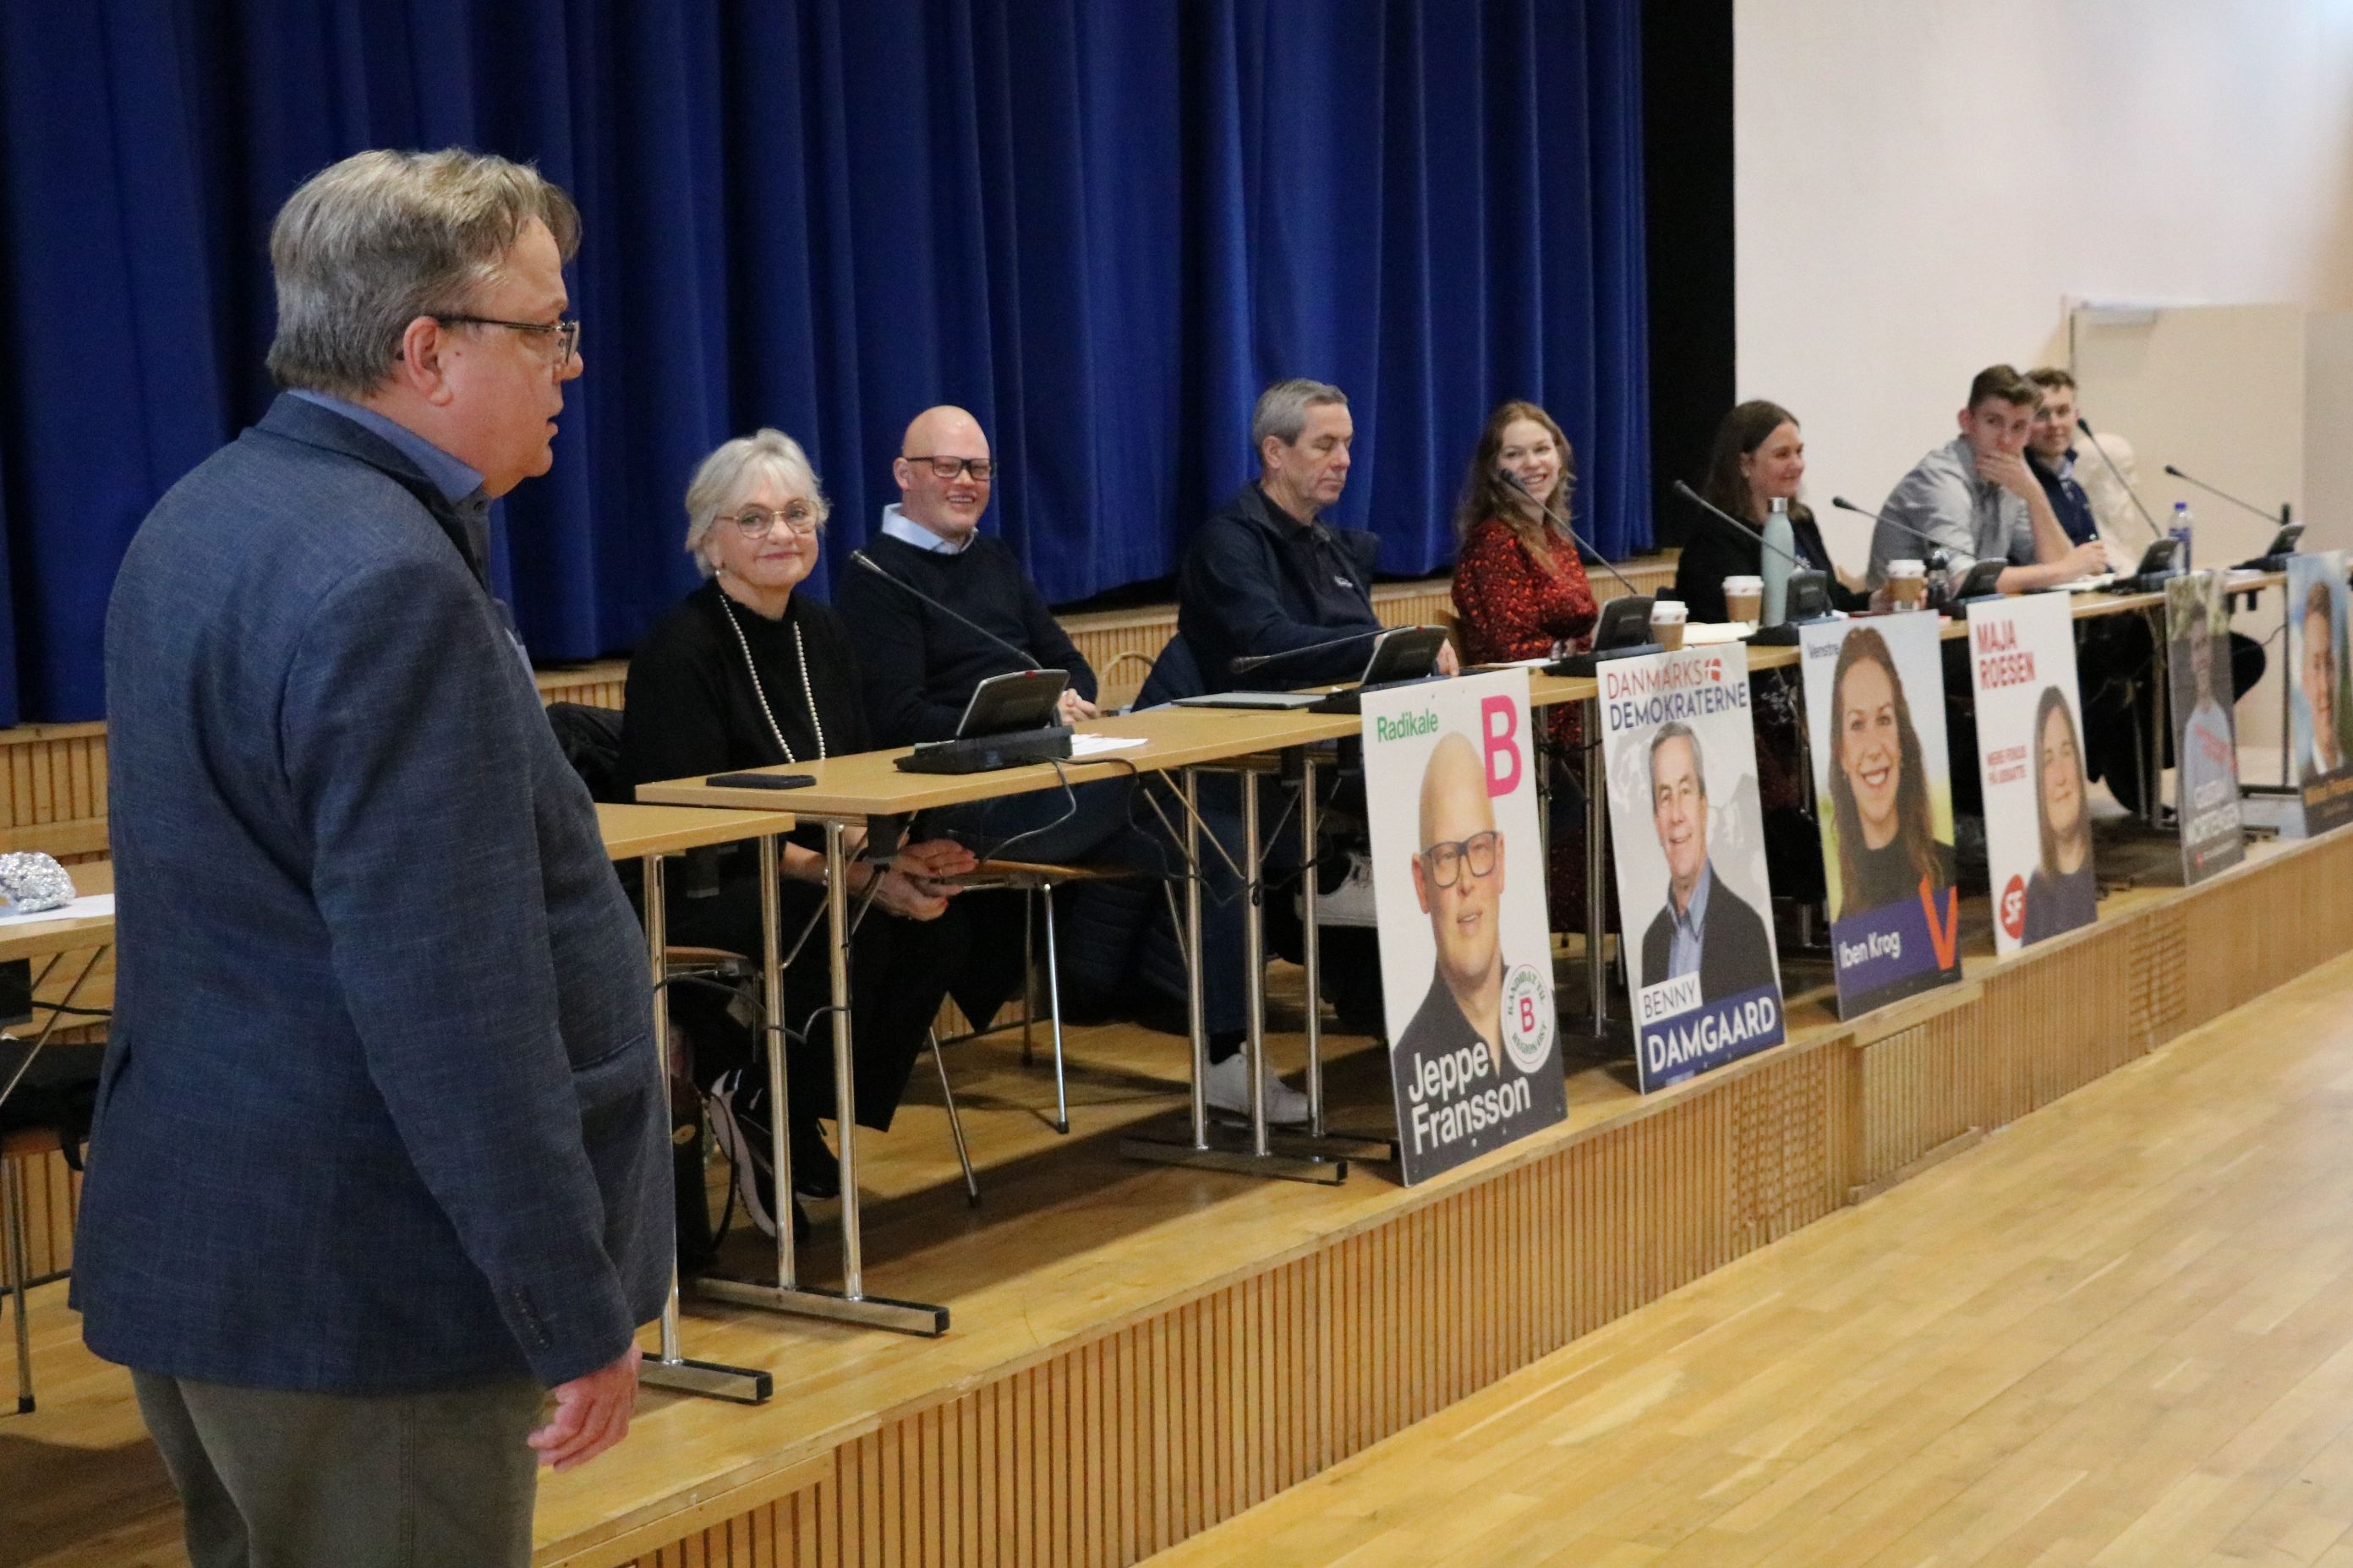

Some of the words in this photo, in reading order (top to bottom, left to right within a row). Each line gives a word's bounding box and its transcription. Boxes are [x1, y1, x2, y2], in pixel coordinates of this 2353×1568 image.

[1977, 620, 2016, 654] MAJA
[1607, 659, 1703, 700] DANMARKS
[1980, 652, 2035, 690] ROESEN
[1376, 708, 1438, 742] Radikale
[1610, 681, 1748, 731] DEMOKRATERNE
[1481, 695, 1522, 798] B
[1918, 875, 1958, 970] V
[2005, 889, 2023, 925] SF
[1839, 941, 1869, 969] Iben
[1868, 932, 1901, 959] Krog
[1520, 997, 1535, 1033] B
[1644, 979, 1695, 1019] BENNY
[1648, 997, 1776, 1074] DAMGAARD
[1409, 1042, 1489, 1102] Jeppe
[1412, 1077, 1531, 1156] Fransson
